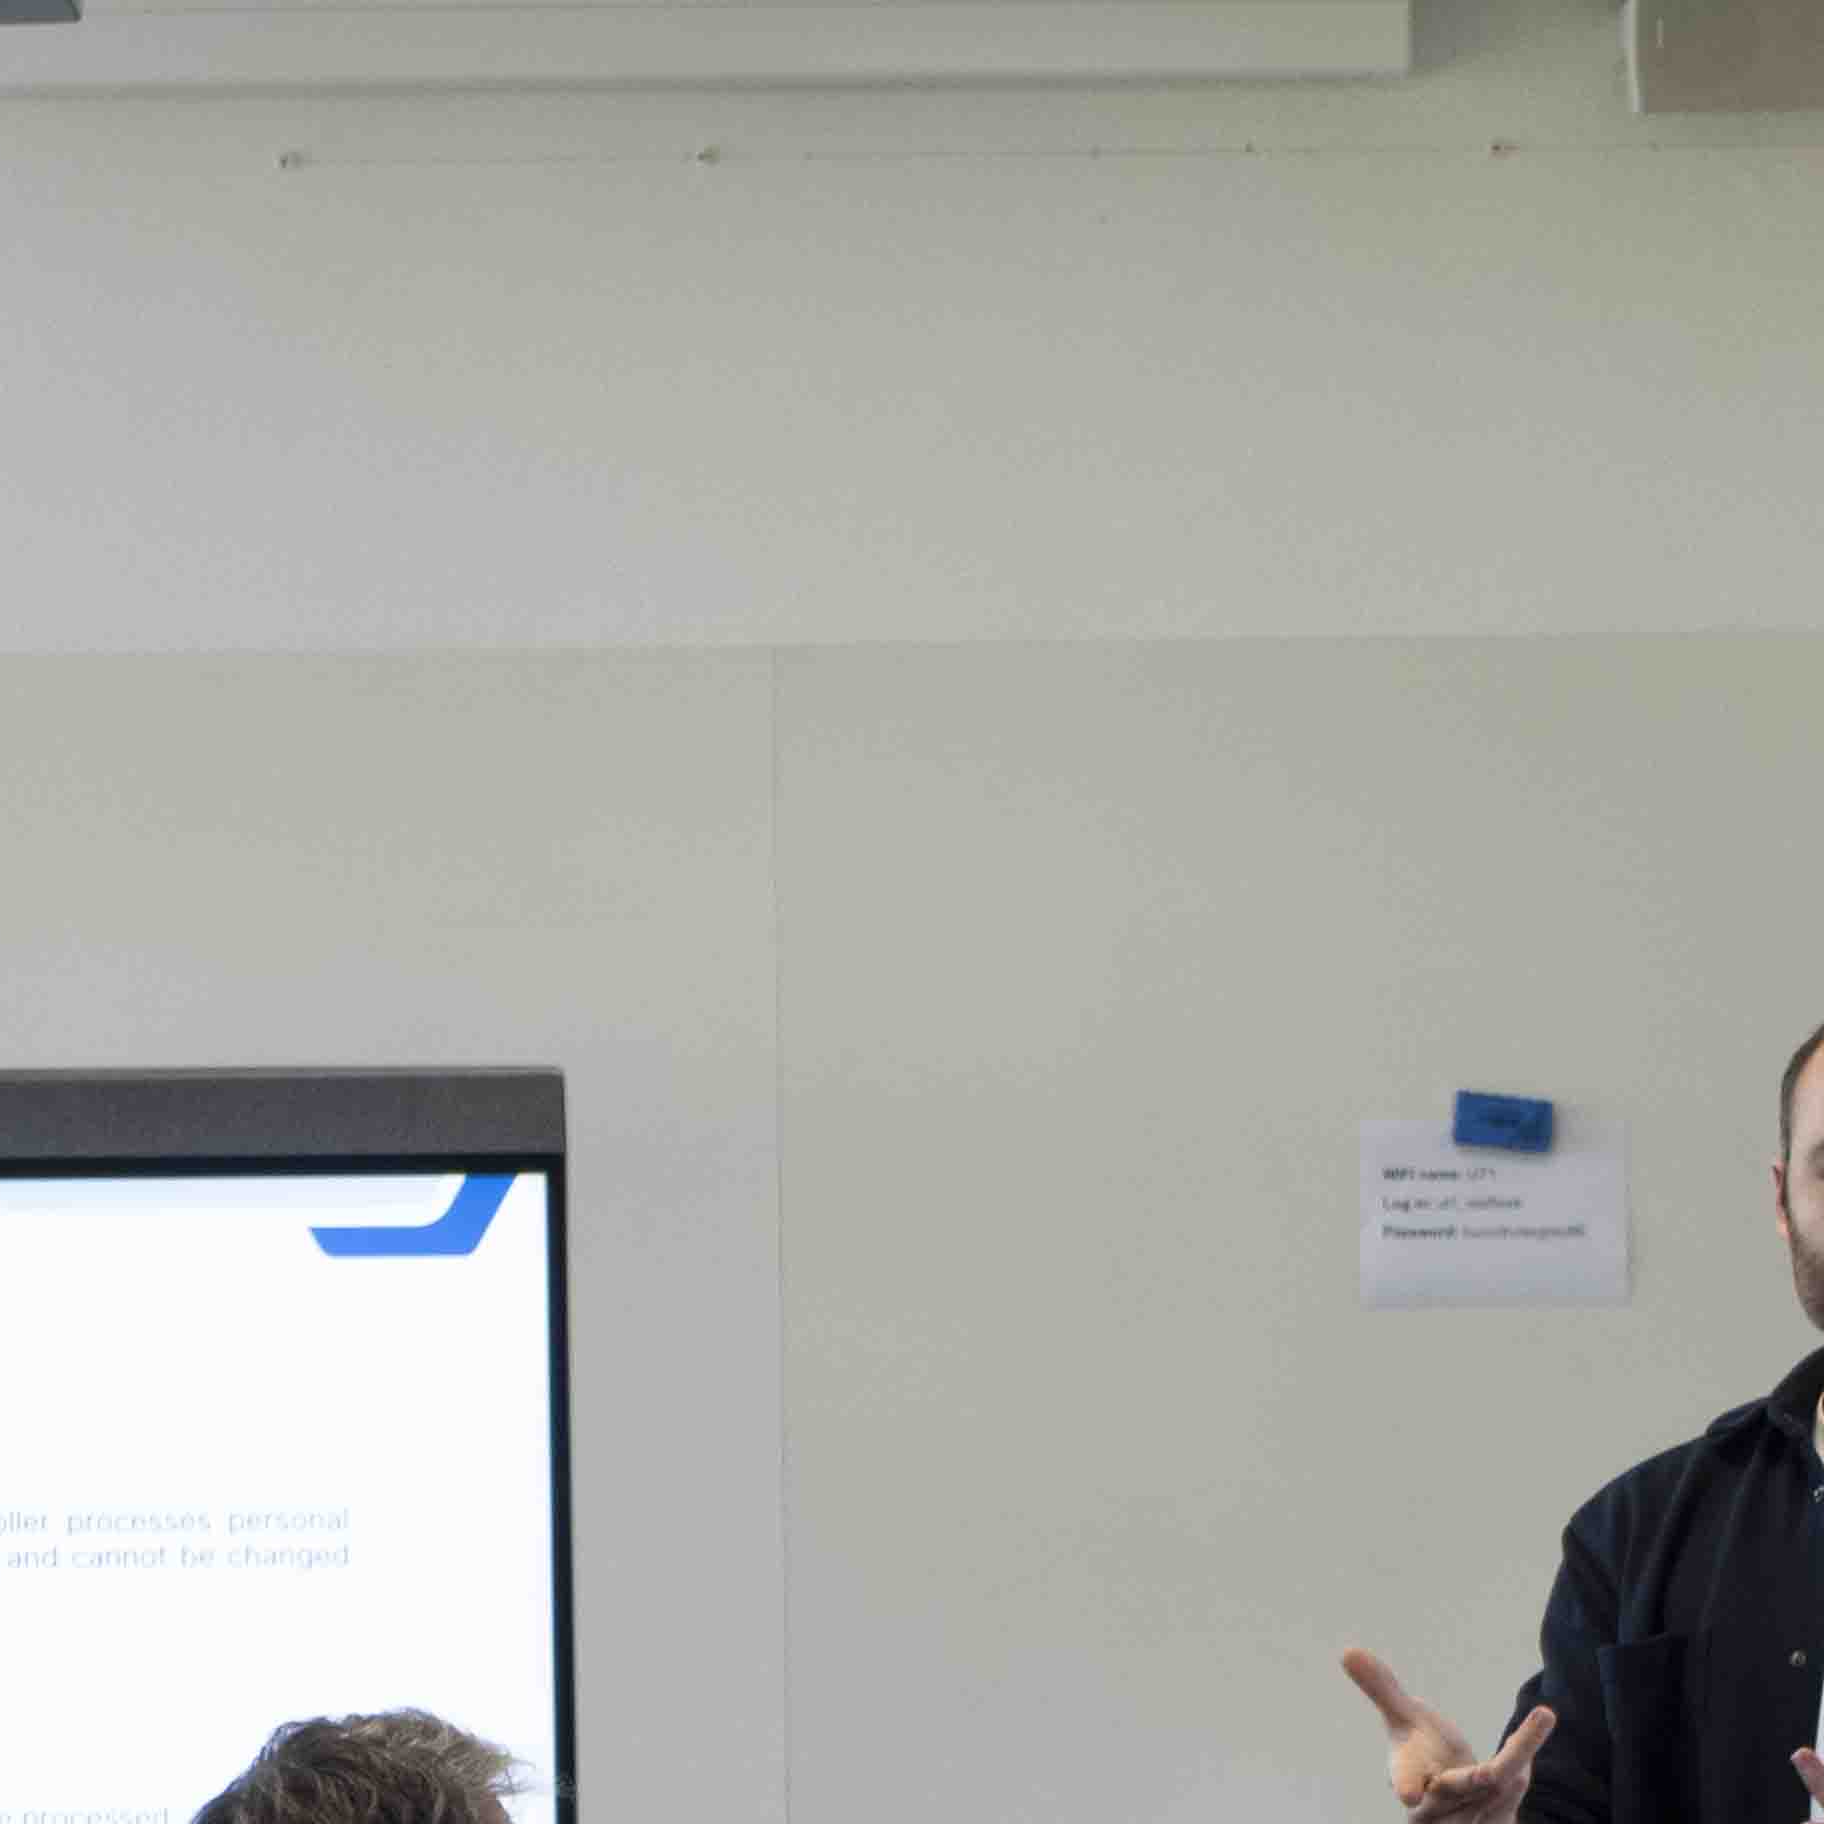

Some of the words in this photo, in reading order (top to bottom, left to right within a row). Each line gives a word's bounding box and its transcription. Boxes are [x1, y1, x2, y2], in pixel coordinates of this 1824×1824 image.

[66, 1511, 212, 1539] processes
[228, 1508, 349, 1537] personal
[7, 1545, 58, 1570] and
[71, 1547, 168, 1570] cannot
[180, 1544, 215, 1569] be
[227, 1544, 350, 1574] changed
